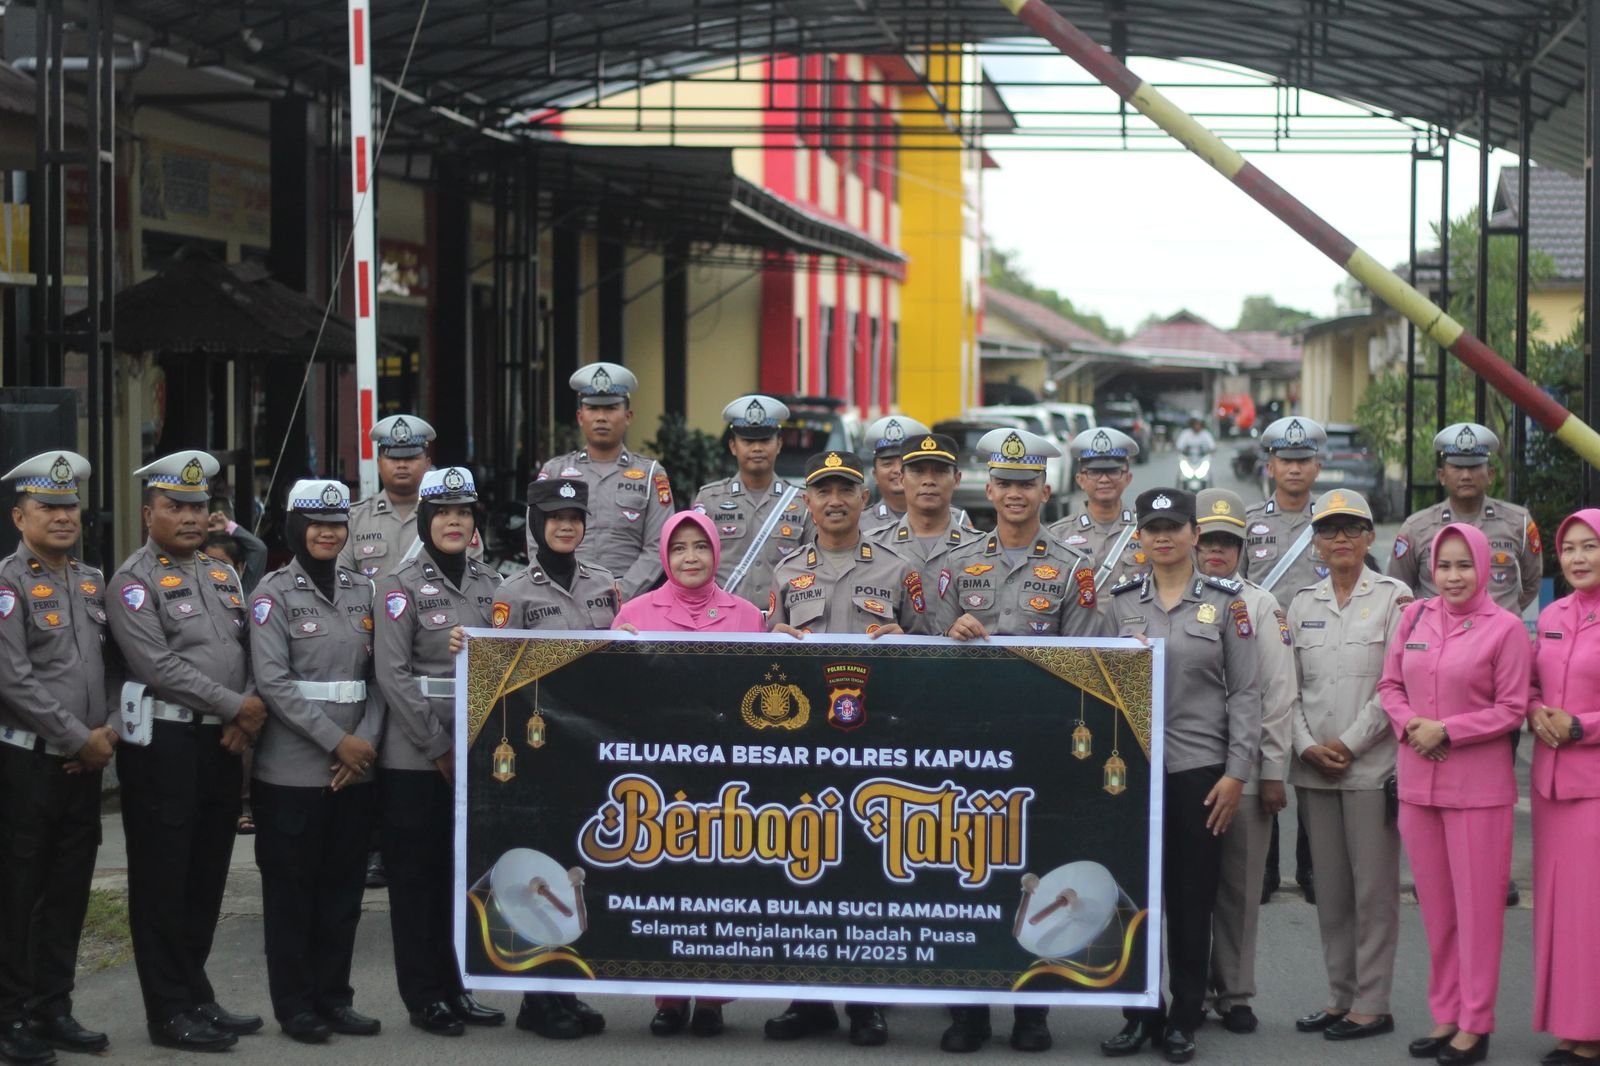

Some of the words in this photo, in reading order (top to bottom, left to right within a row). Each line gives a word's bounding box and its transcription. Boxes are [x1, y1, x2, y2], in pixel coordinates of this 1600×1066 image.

[618, 482, 648, 493] POLRI
[779, 514, 802, 523] OLRI
[356, 532, 383, 541] CAHYO
[962, 579, 991, 589] BIMA
[1023, 580, 1061, 595] POLRI
[790, 588, 823, 604] CATUR.W
[855, 585, 891, 599] POLRI
[33, 600, 60, 611] FERDY
[291, 607, 319, 617] DEVI
[826, 665, 846, 673] POLRES
[847, 665, 867, 674] KAPUAS
[599, 742, 726, 763] KELUARGA
[732, 745, 809, 765] BESAR
[816, 747, 908, 767] POLRES
[914, 749, 1013, 769] KAPUAS
[577, 773, 844, 886] Berbagi
[850, 777, 1035, 888] Takjil
[608, 895, 675, 911] DALAM
[680, 897, 762, 914] RANGKA
[767, 899, 833, 916] BULAN
[838, 901, 882, 917] SUCI
[888, 902, 1001, 919] RAMADHAN
[631, 919, 708, 936] Selamat
[715, 922, 838, 942] Menjalankan
[846, 925, 912, 942] Ibadah
[920, 927, 977, 943] Puasa
[672, 940, 774, 957] Ramadhan
[782, 943, 828, 959] 1446
[836, 944, 908, 962] H/2025
[916, 946, 935, 962] M
